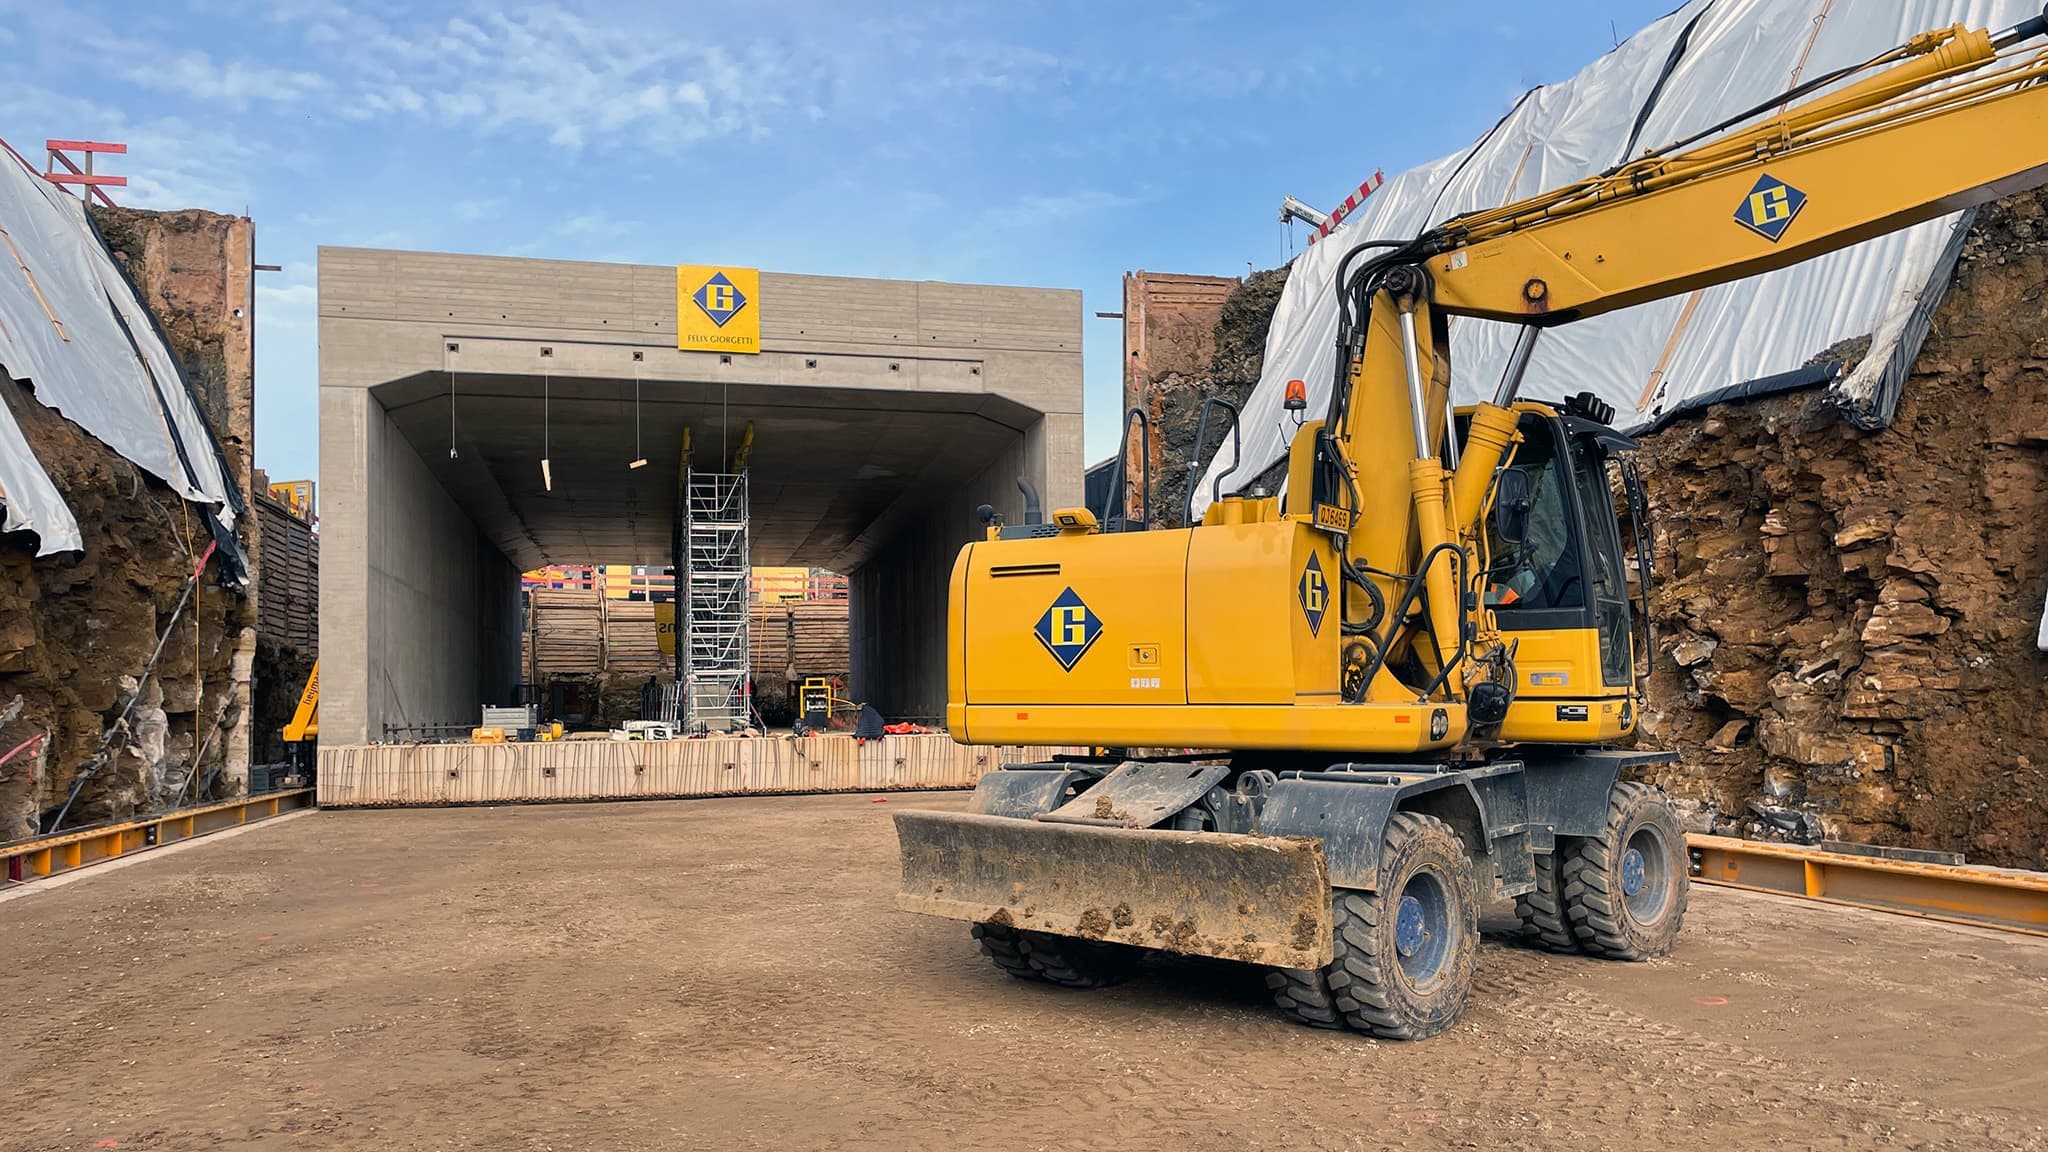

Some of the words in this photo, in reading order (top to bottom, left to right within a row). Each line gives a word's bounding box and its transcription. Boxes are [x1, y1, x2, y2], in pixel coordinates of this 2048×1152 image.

[1749, 184, 1791, 226] G
[706, 283, 734, 312] G
[687, 334, 709, 343] FELIX
[710, 335, 753, 345] GIORGETTI
[1305, 568, 1322, 612] G
[1051, 605, 1086, 646] G
